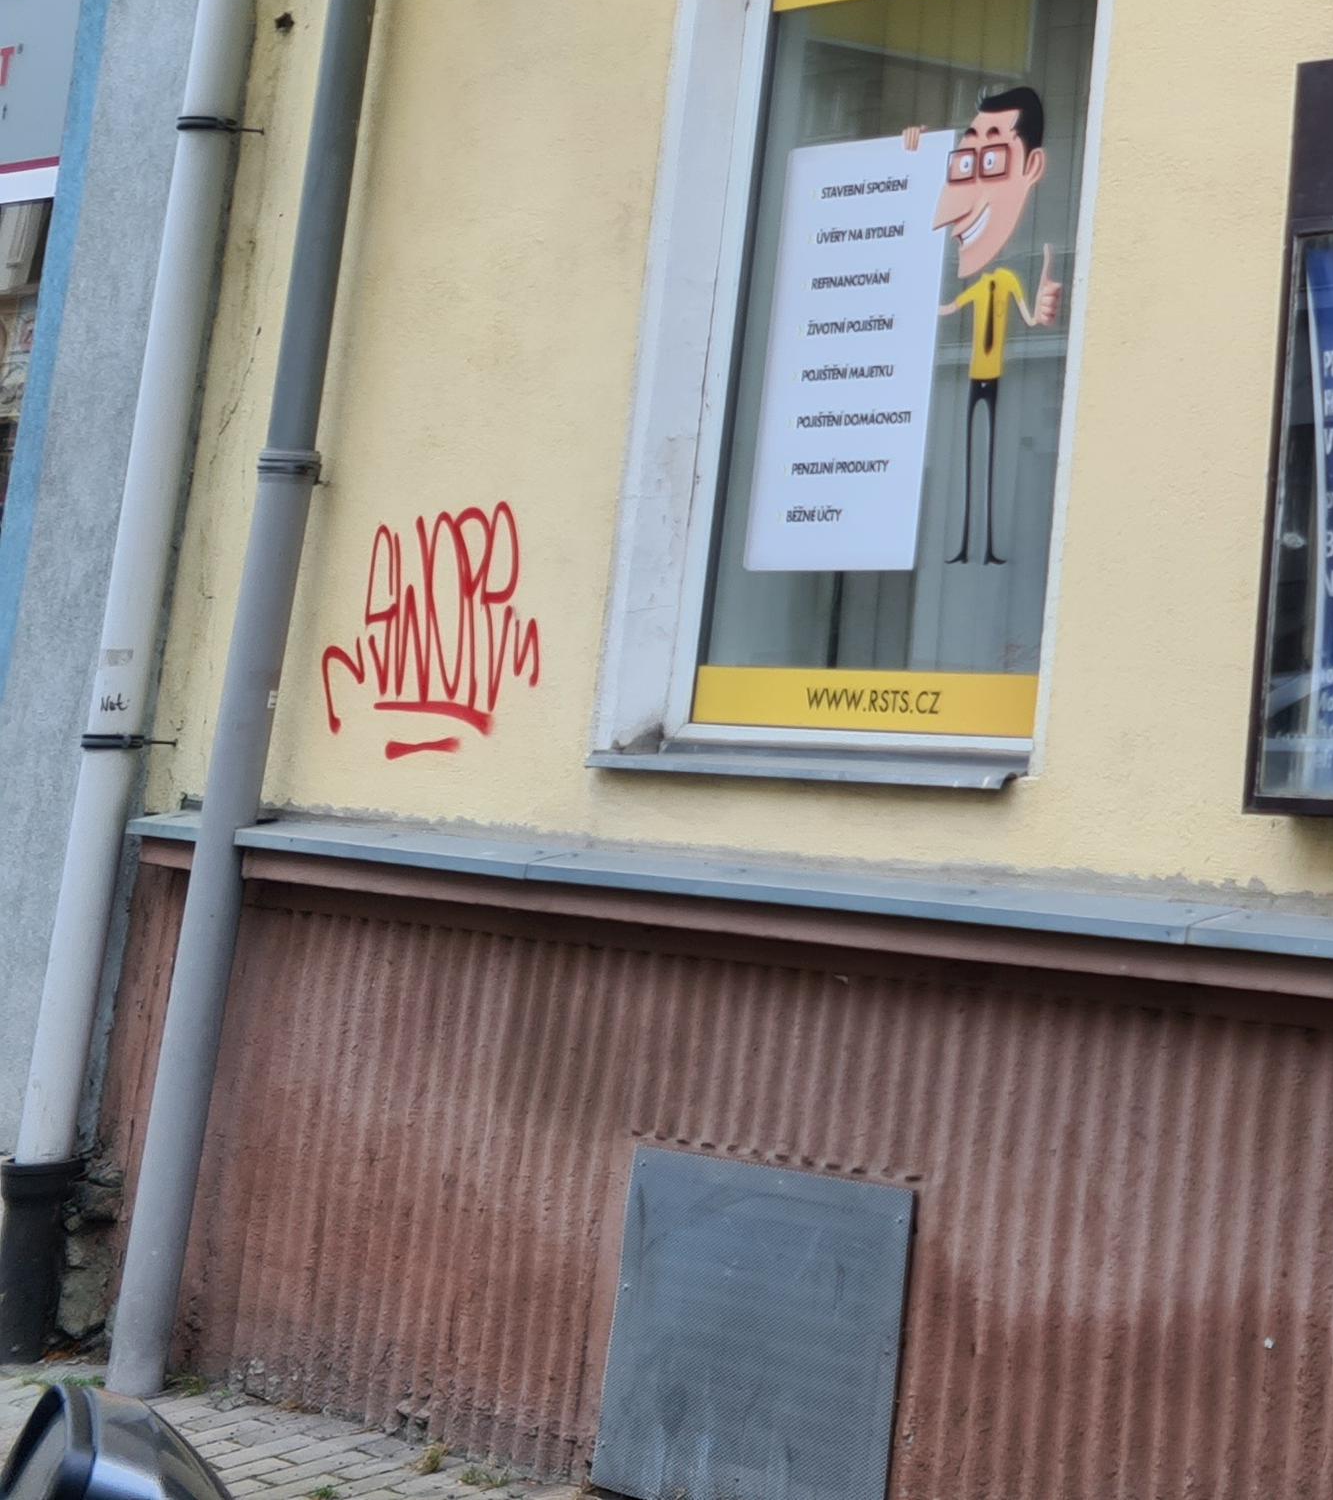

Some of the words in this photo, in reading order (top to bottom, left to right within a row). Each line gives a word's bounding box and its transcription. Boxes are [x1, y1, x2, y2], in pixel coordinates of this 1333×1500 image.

[821, 180, 865, 199] STAVEBNÍ
[866, 175, 909, 194] SPOŘENÍ
[816, 227, 848, 244] ÚVĚRY
[848, 229, 864, 242] NA
[864, 221, 905, 240] BYDLENÍ
[811, 268, 891, 290] REFINANCOVÁNÍ
[807, 318, 846, 336] ŽIVOTNÍ
[846, 314, 895, 333] POJIŠTĚNÍ
[801, 364, 848, 382] POJIŠTĚNÍ
[848, 364, 895, 380] MAJETKU
[796, 411, 844, 428] POJIŠTĚNÍ
[844, 409, 912, 427] DOMÁCNOSTI
[835, 460, 889, 474] PRODUKTY
[786, 505, 816, 522] BĚŽNÉ
[807, 687, 942, 715] WWW.RSTS.CZ
